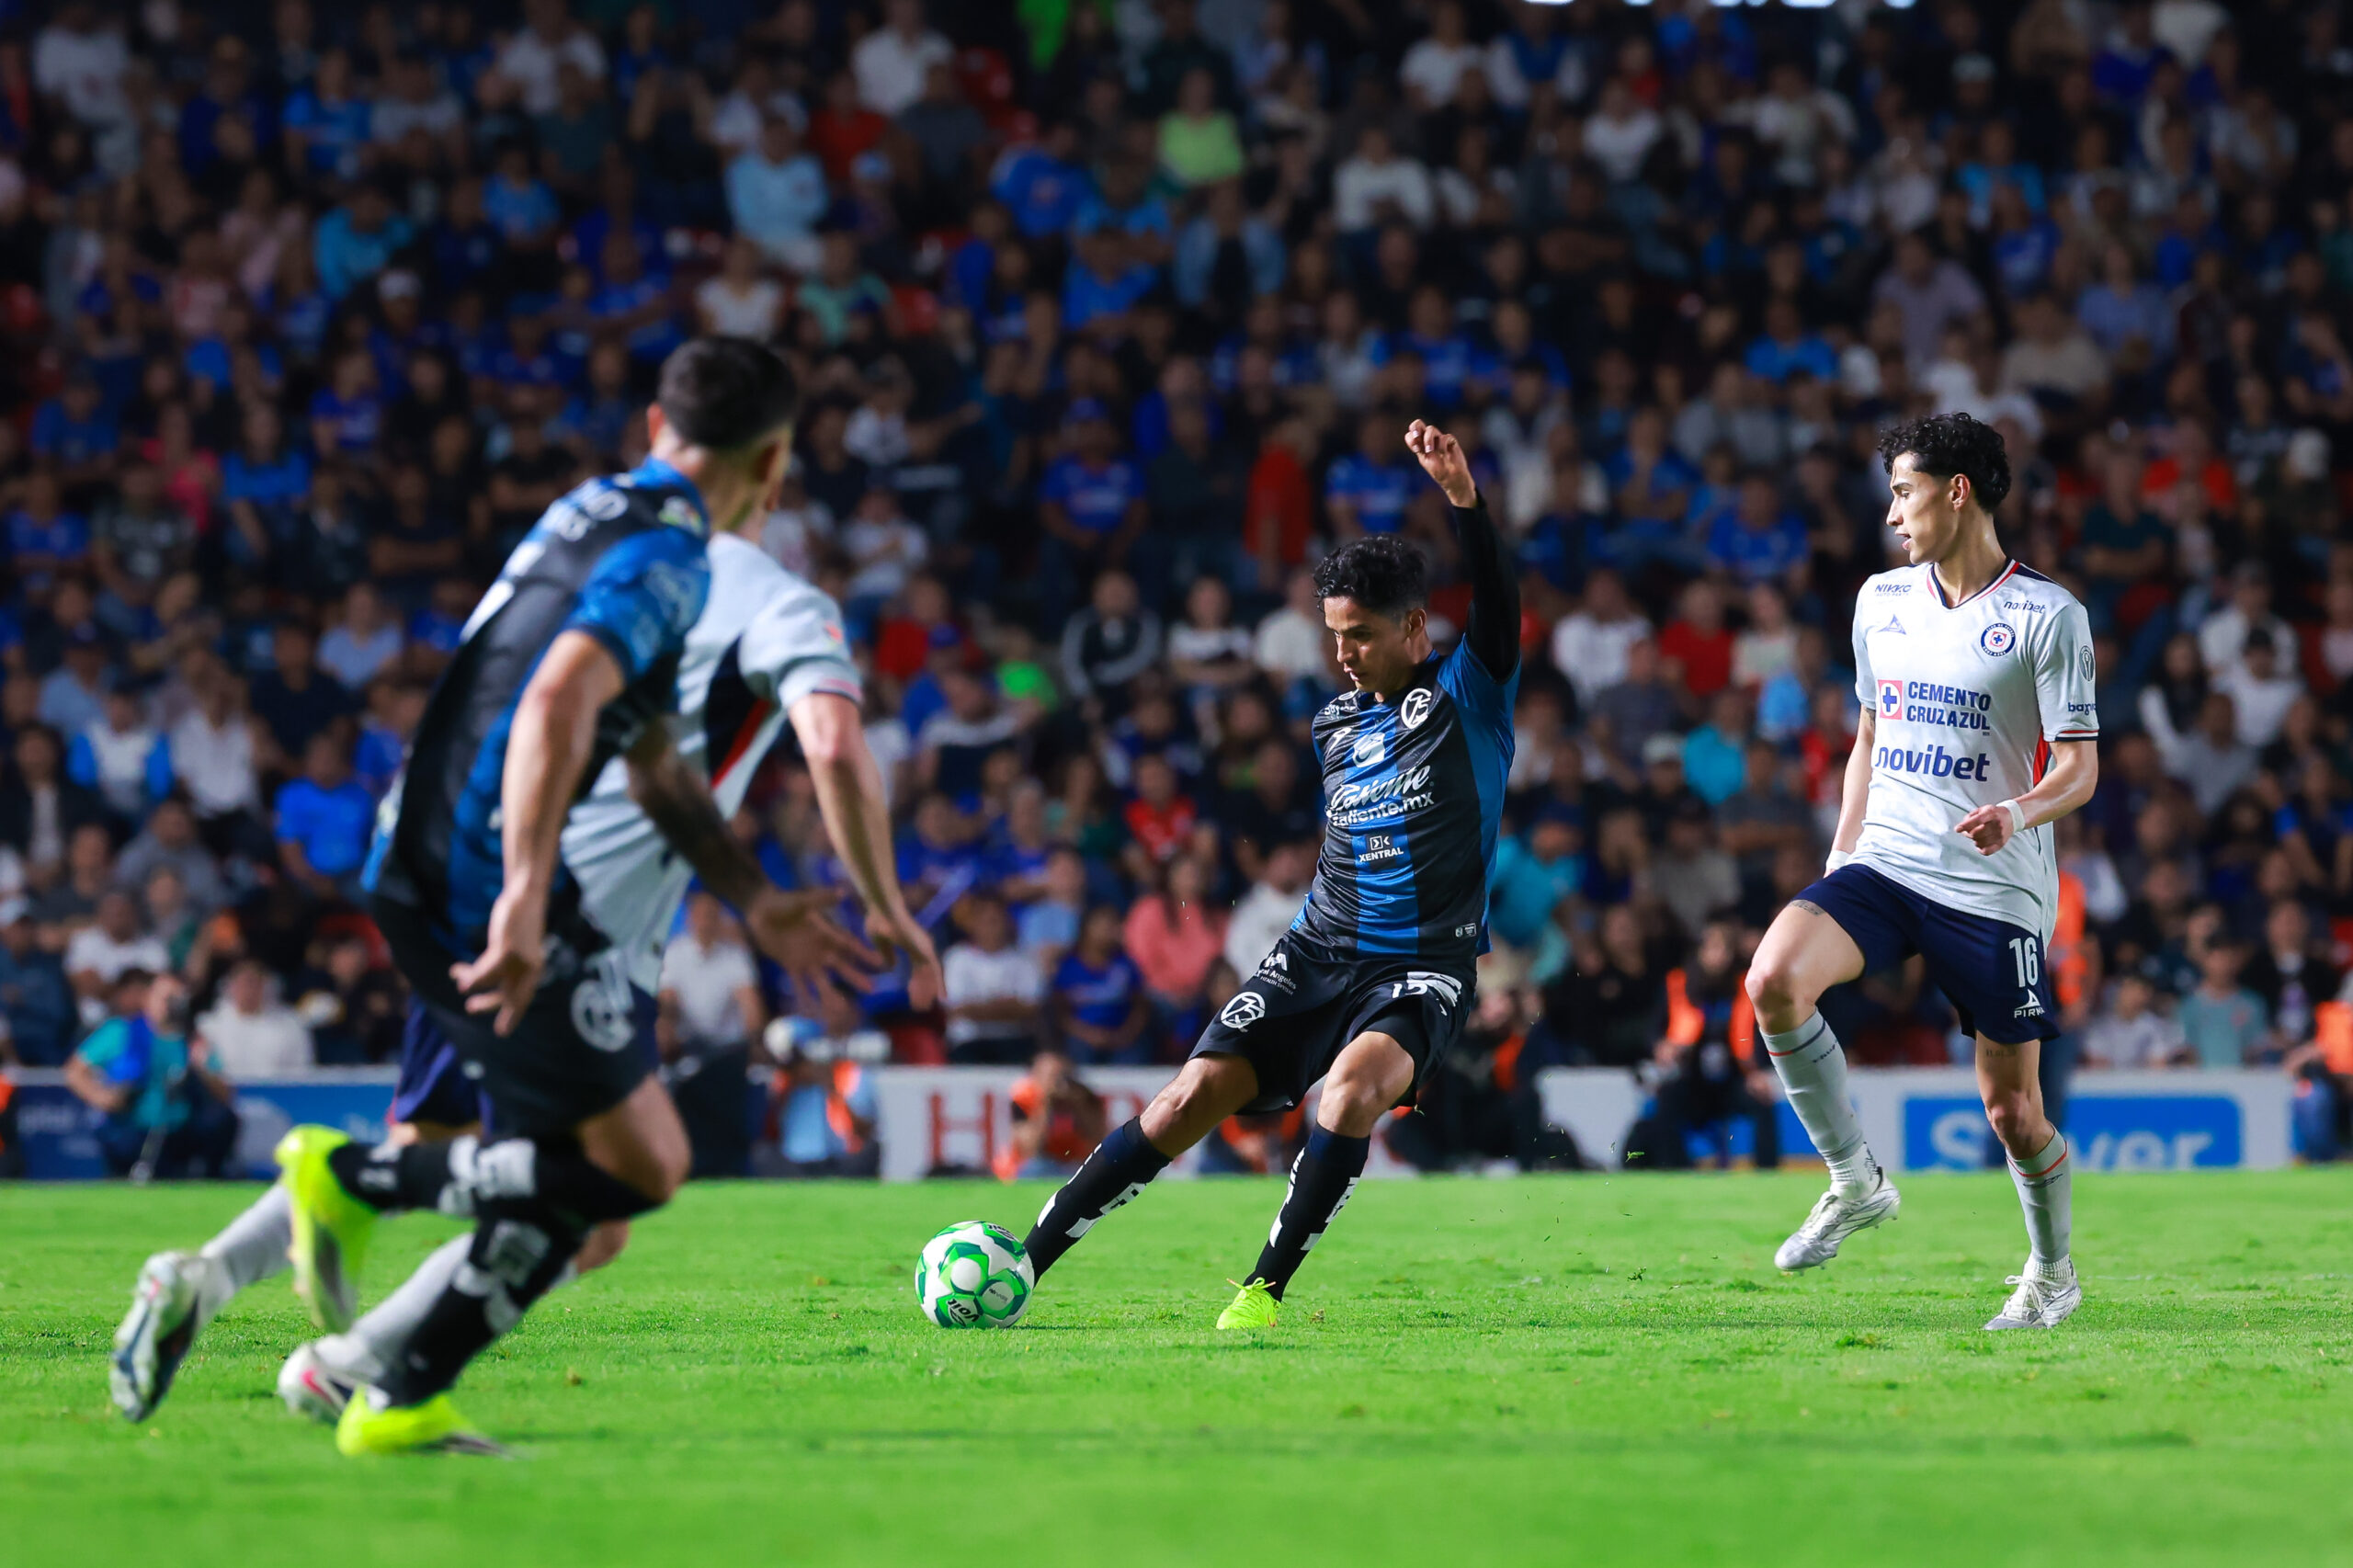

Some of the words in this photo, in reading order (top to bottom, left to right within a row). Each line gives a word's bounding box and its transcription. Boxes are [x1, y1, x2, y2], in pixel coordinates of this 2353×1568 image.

[2004, 600, 2046, 614] novibet
[1908, 681, 1991, 711] CEMENTO
[1875, 744, 1990, 781] novibet
[1358, 847, 1404, 863] XENTRAL
[2009, 937, 2039, 988] 16
